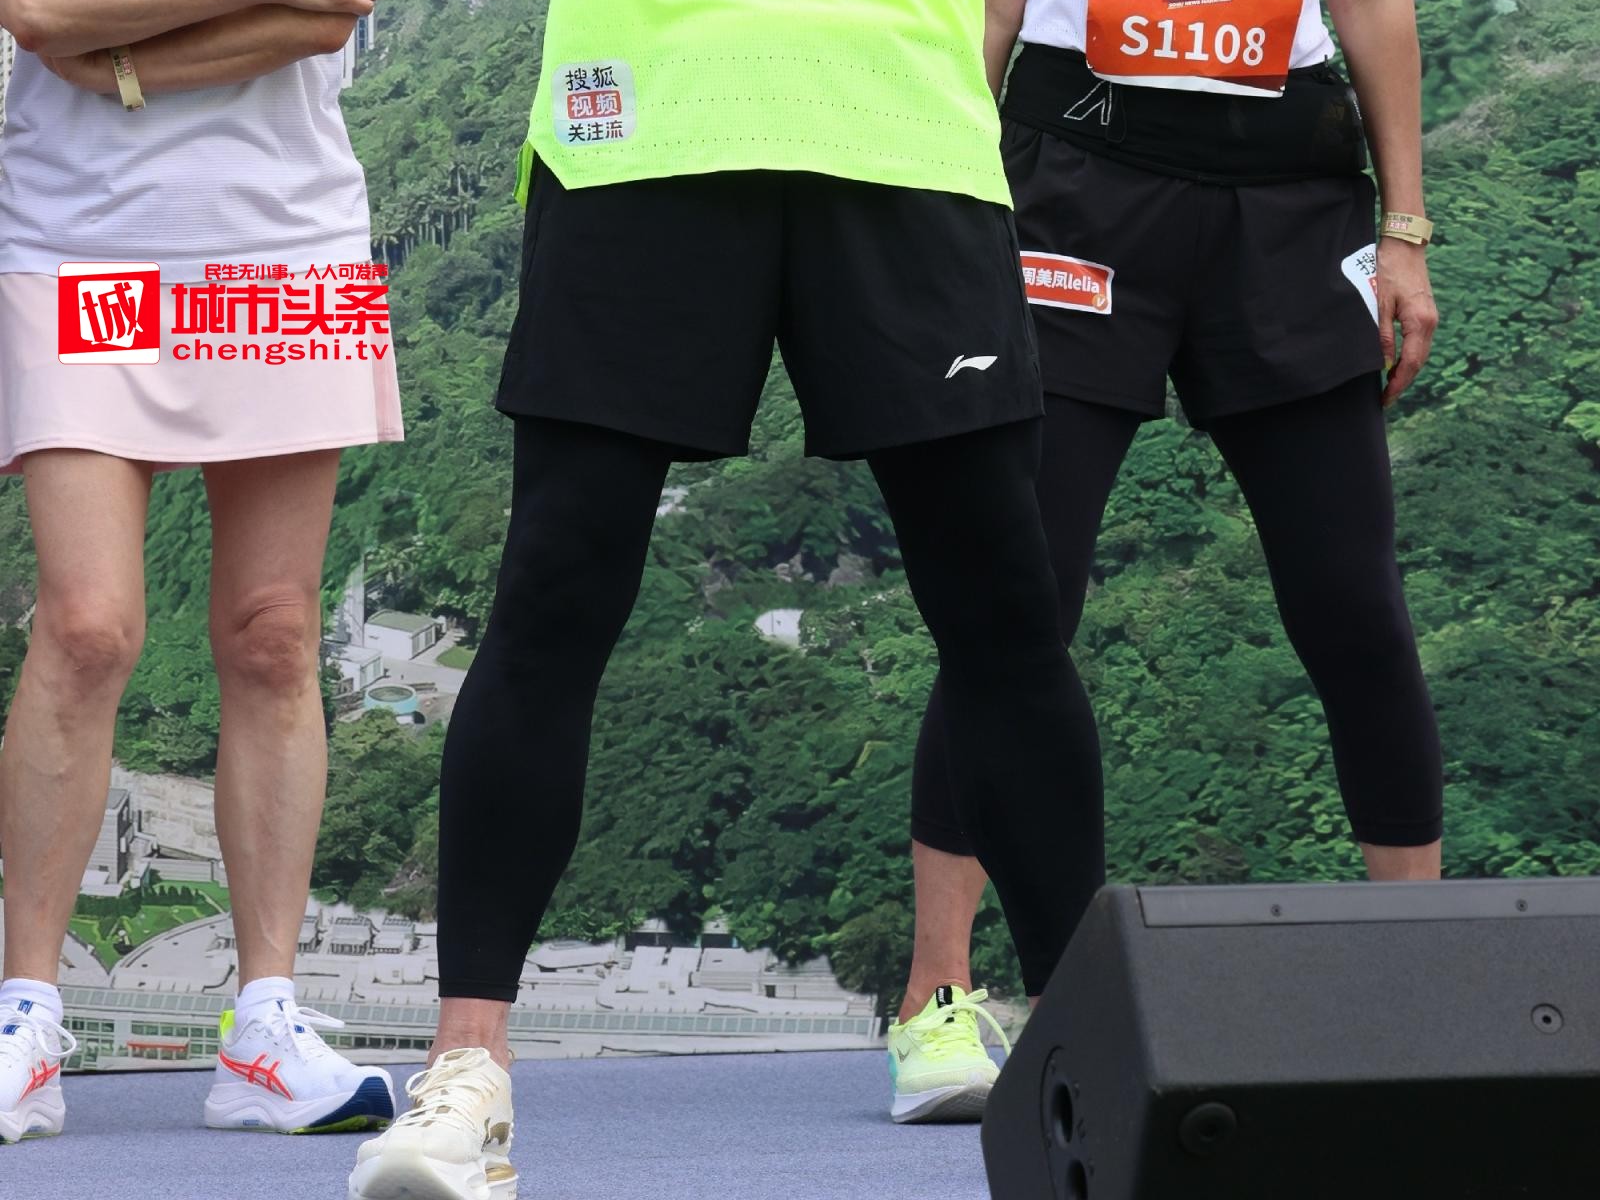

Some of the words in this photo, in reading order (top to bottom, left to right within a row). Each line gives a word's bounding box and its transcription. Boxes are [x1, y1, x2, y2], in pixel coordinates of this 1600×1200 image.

[1119, 15, 1266, 66] S1108
[565, 65, 619, 91] 搜狐
[571, 93, 619, 117] 视频
[568, 120, 624, 143] 关注流
